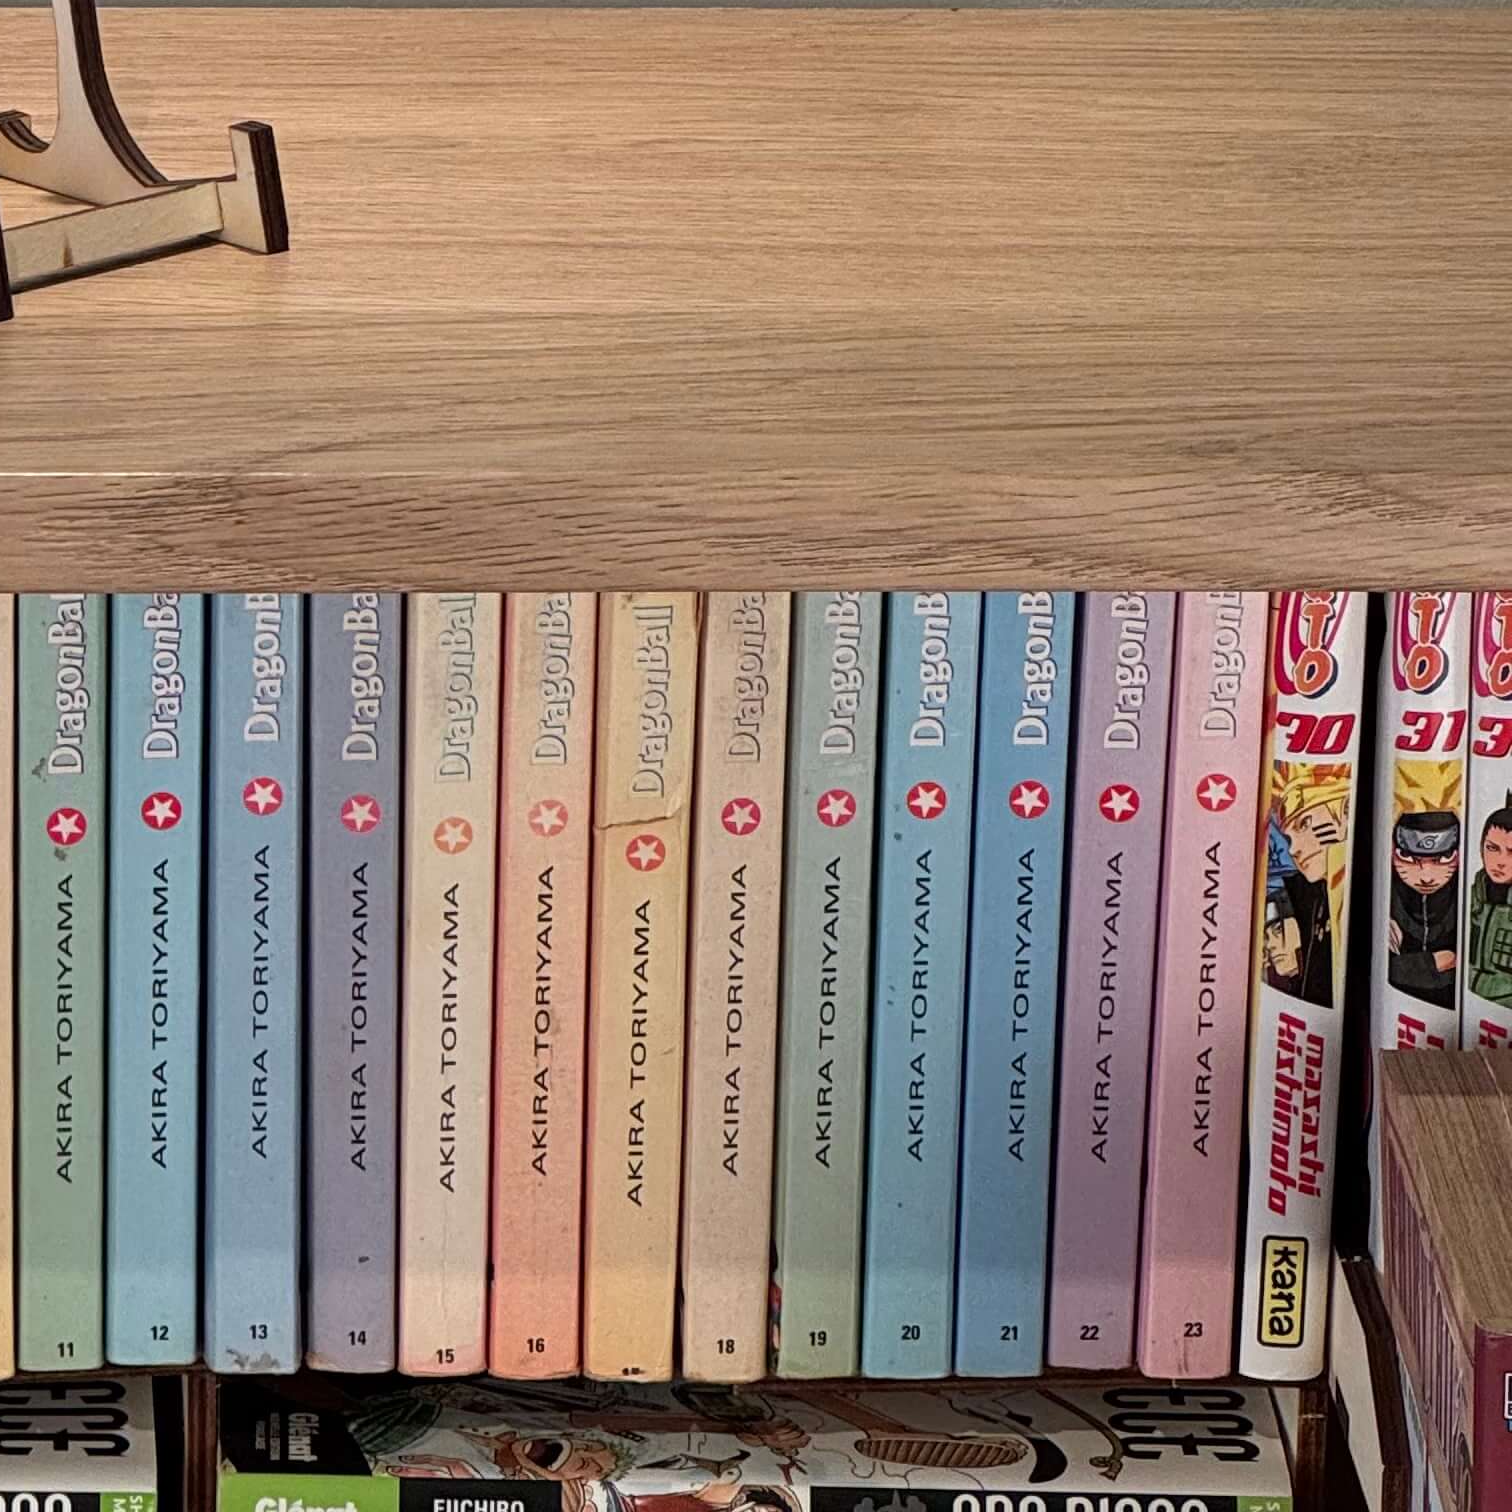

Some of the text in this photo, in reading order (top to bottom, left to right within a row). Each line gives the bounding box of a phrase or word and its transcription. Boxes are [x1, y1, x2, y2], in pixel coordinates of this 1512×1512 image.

[47, 593, 90, 774] DragonBal
[143, 593, 185, 760] DragonBa
[244, 593, 287, 742] DragonB
[342, 593, 385, 761] DragonBa
[435, 593, 478, 784] DragonBal
[530, 592, 575, 765] DragonBa
[632, 605, 674, 799] DragonBall
[725, 592, 769, 763] DragonBa
[910, 592, 954, 746] DragonB
[1013, 592, 1057, 745] DragonB
[1103, 592, 1150, 750] DragonB
[1200, 592, 1246, 738] DragonB
[1394, 710, 1467, 753] 31
[1473, 716, 1512, 758] 3
[56, 873, 73, 1184] AKIRA TORIYAMA
[151, 858, 169, 1169] AKIRA TORIYAMA
[251, 844, 270, 1160] AKIRA TORIYAMA
[350, 861, 369, 1172] AKIRA TORIYAMA
[439, 882, 460, 1193] AKIRA TORIYAMA
[531, 865, 554, 1177] AKIRA TORIYAMA
[626, 899, 651, 1208] AKIRA TORIYAMA
[722, 863, 748, 1177] AKIRA TORIYAMA
[815, 855, 841, 1169] AKIRA TORIYAMA
[907, 848, 933, 1163] AKIRA TORIYAMA
[1008, 847, 1035, 1163] AKIRA TORIYAMA
[1090, 851, 1124, 1164] AKIRA TORIYAMA
[1192, 841, 1222, 1158] AKIRA TORIYAMA
[57, 1341, 74, 1358] 11
[150, 1325, 169, 1341] 12
[249, 1324, 268, 1340] 13
[348, 1330, 367, 1346] 14
[435, 1348, 455, 1365] 15
[526, 1337, 545, 1354] 16
[716, 1338, 735, 1355] 18
[809, 1330, 827, 1347] 19
[900, 1324, 921, 1341] 20
[999, 1325, 1018, 1342] 21
[1079, 1324, 1100, 1341] 22
[1183, 1321, 1203, 1338] 23
[1269, 1246, 1297, 1336] kana
